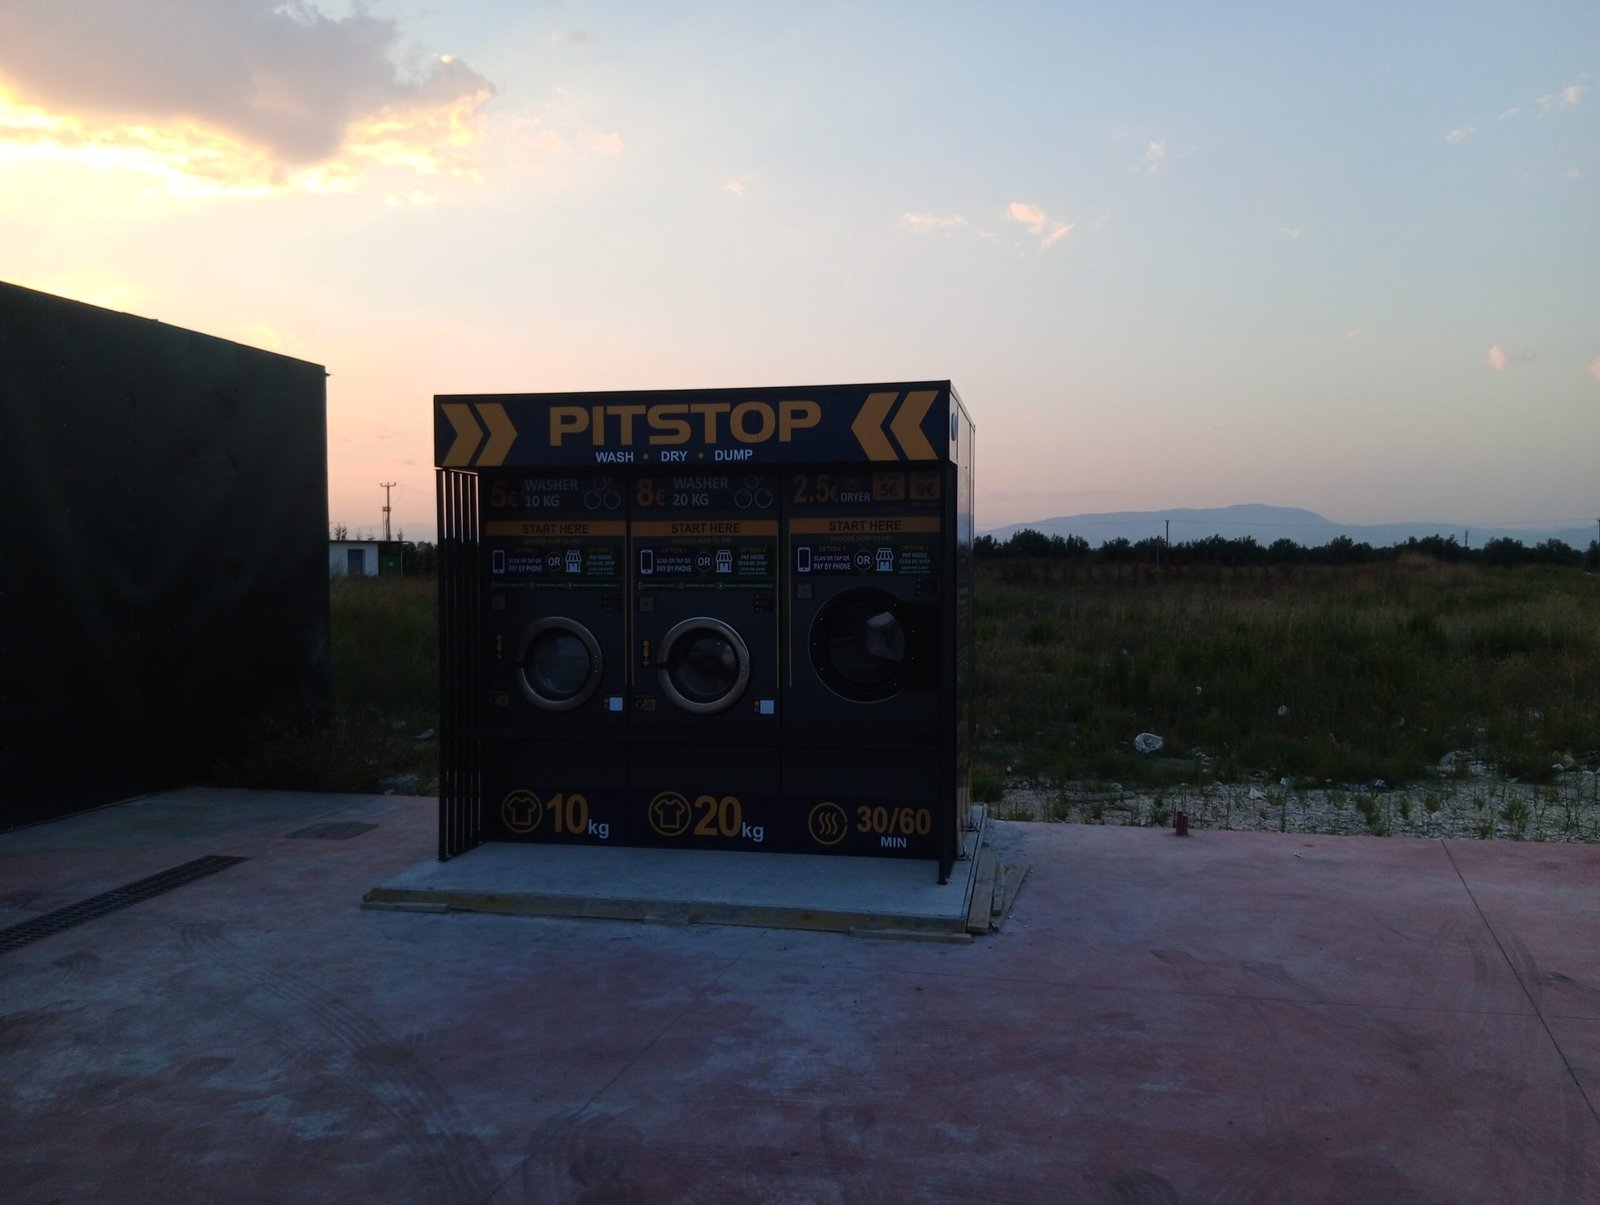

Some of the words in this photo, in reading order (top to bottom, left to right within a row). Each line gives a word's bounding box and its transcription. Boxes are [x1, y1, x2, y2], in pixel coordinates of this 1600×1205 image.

[550, 400, 821, 447] PITSTOP
[595, 452, 634, 463] WASH
[661, 451, 688, 462] DRY
[714, 449, 753, 461] DUMP
[524, 479, 578, 491] WASHER
[672, 477, 728, 489] WASHER
[916, 482, 936, 496] 9€
[637, 477, 667, 507] 8€
[879, 483, 898, 496] 5€
[524, 495, 539, 507] 10
[543, 495, 560, 507] KG
[672, 494, 688, 506] 20
[692, 494, 709, 506] KG
[840, 492, 871, 502] DRYER
[522, 524, 559, 534] START
[560, 524, 589, 534] HERE
[671, 523, 705, 533] START
[710, 523, 740, 533] HERE
[828, 520, 865, 531] START
[870, 520, 902, 531] HERE
[548, 557, 560, 566] OR
[697, 557, 711, 566] OR
[813, 562, 823, 570] PAY
[824, 562, 832, 570] BY
[832, 562, 851, 570] PHONE
[857, 555, 871, 565] OR
[856, 805, 932, 835] 30/60
[880, 836, 907, 848] MIN
